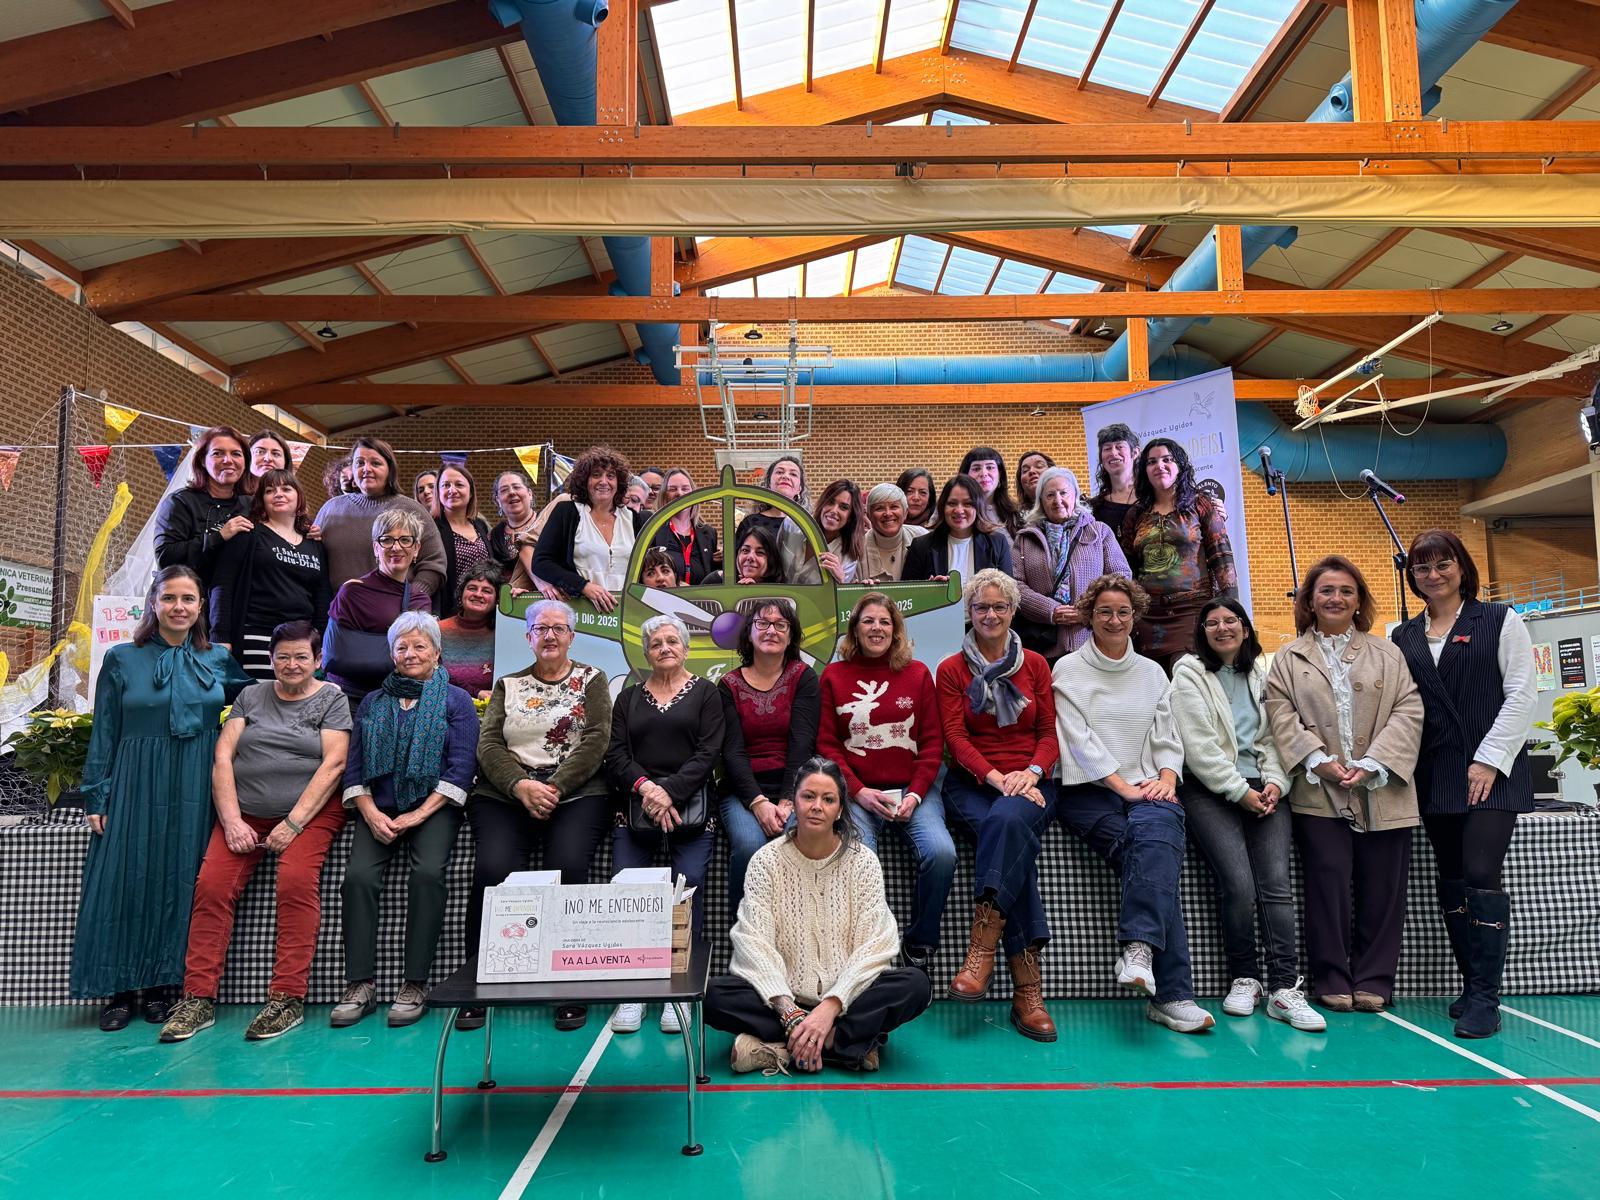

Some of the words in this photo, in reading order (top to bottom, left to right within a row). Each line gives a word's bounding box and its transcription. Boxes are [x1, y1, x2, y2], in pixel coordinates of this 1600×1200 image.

[1169, 421, 1193, 431] Ugidos
[896, 599, 913, 612] 025
[581, 613, 595, 625] DIC
[597, 615, 618, 628] 2025
[564, 898, 584, 915] ¡NO
[589, 898, 603, 913] ME
[608, 895, 663, 913] ENTENDÉIS!
[562, 957, 575, 966] YA
[576, 956, 584, 965] A
[585, 956, 599, 965] LA
[600, 955, 631, 964] VENTA
